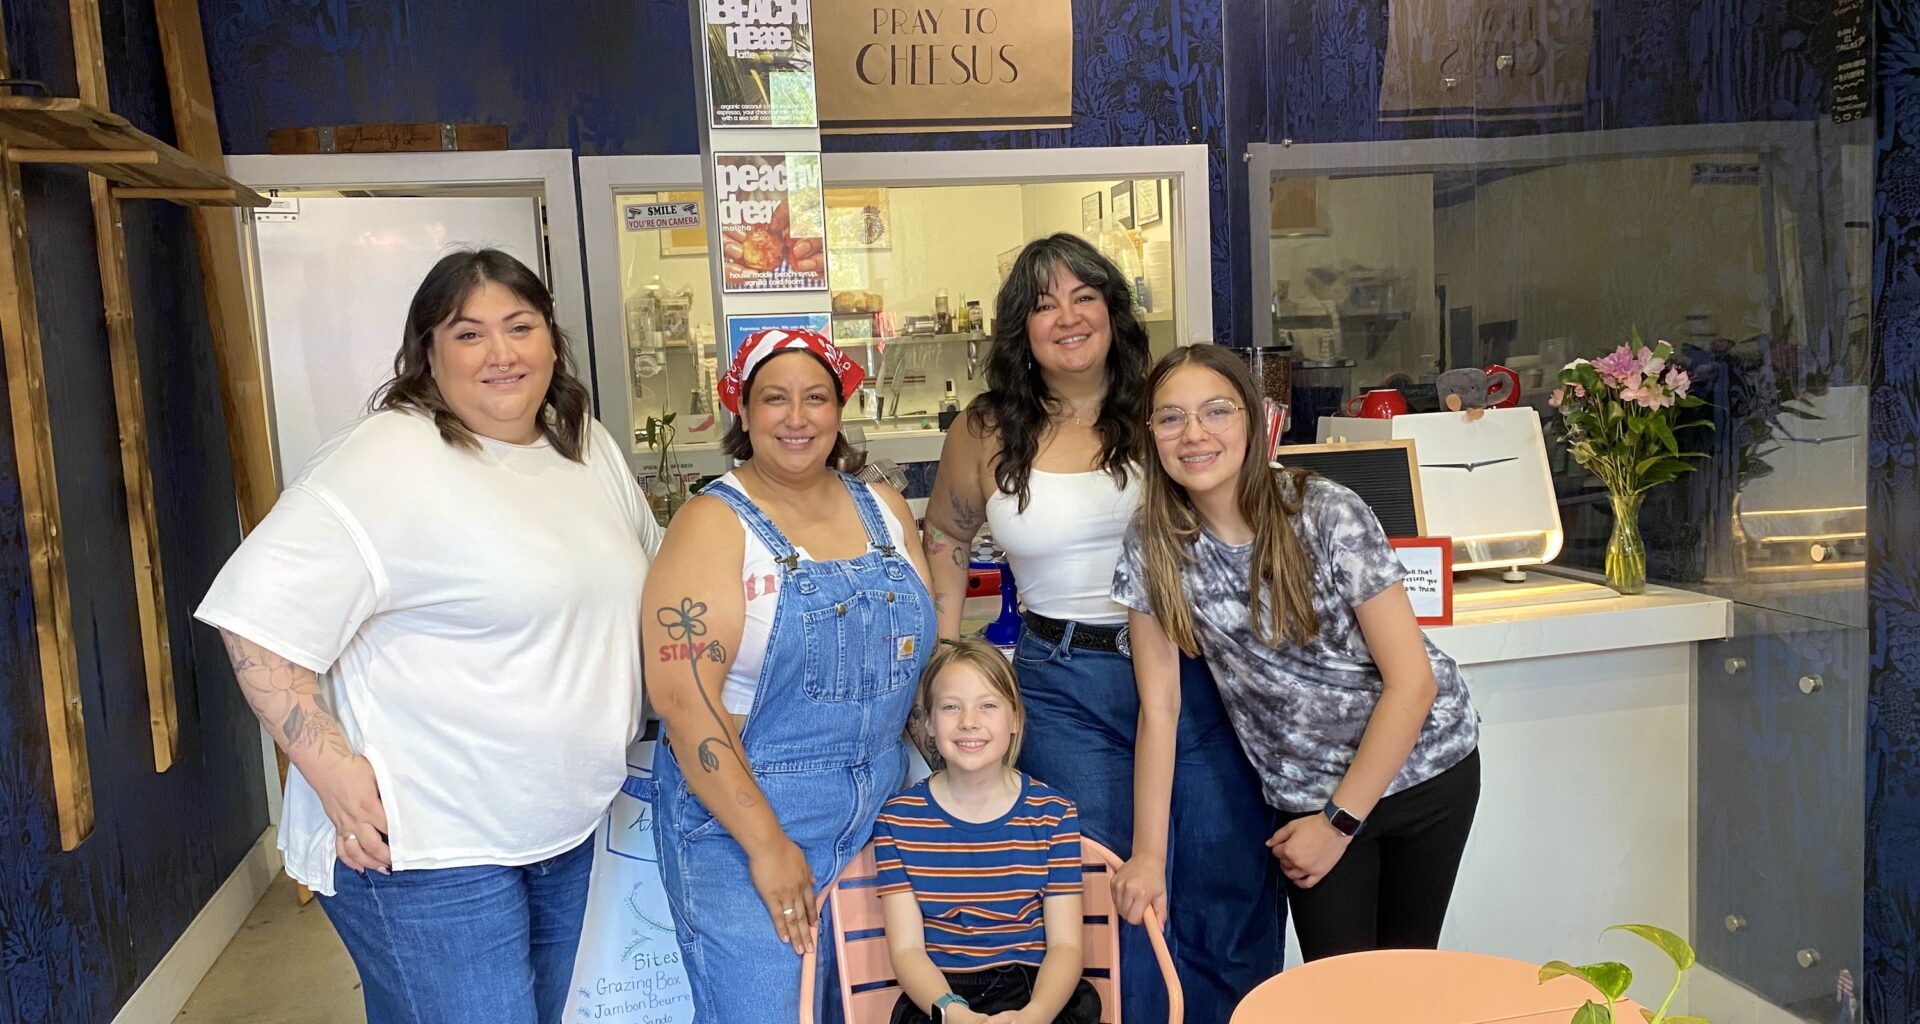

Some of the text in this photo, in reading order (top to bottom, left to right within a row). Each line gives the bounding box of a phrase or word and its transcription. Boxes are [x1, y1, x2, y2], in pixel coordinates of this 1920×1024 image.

[706, 0, 808, 24] BEACH
[873, 7, 998, 35] PRAY TO
[726, 21, 793, 57] please
[855, 43, 1018, 86] CHEESUS
[716, 109, 742, 117] espresso,
[742, 109, 755, 117] your
[720, 103, 741, 111] organic
[647, 205, 678, 216] SMILE
[628, 216, 698, 229] YOU'RE ON CAMERA
[722, 224, 752, 232] matcha
[729, 271, 751, 279] house
[752, 271, 773, 279] made
[774, 270, 797, 279] peach
[659, 642, 706, 662] STAY
[632, 951, 679, 971] Bites
[596, 970, 682, 997] Grazing Box
[594, 993, 691, 1019] Jambon Beurre
